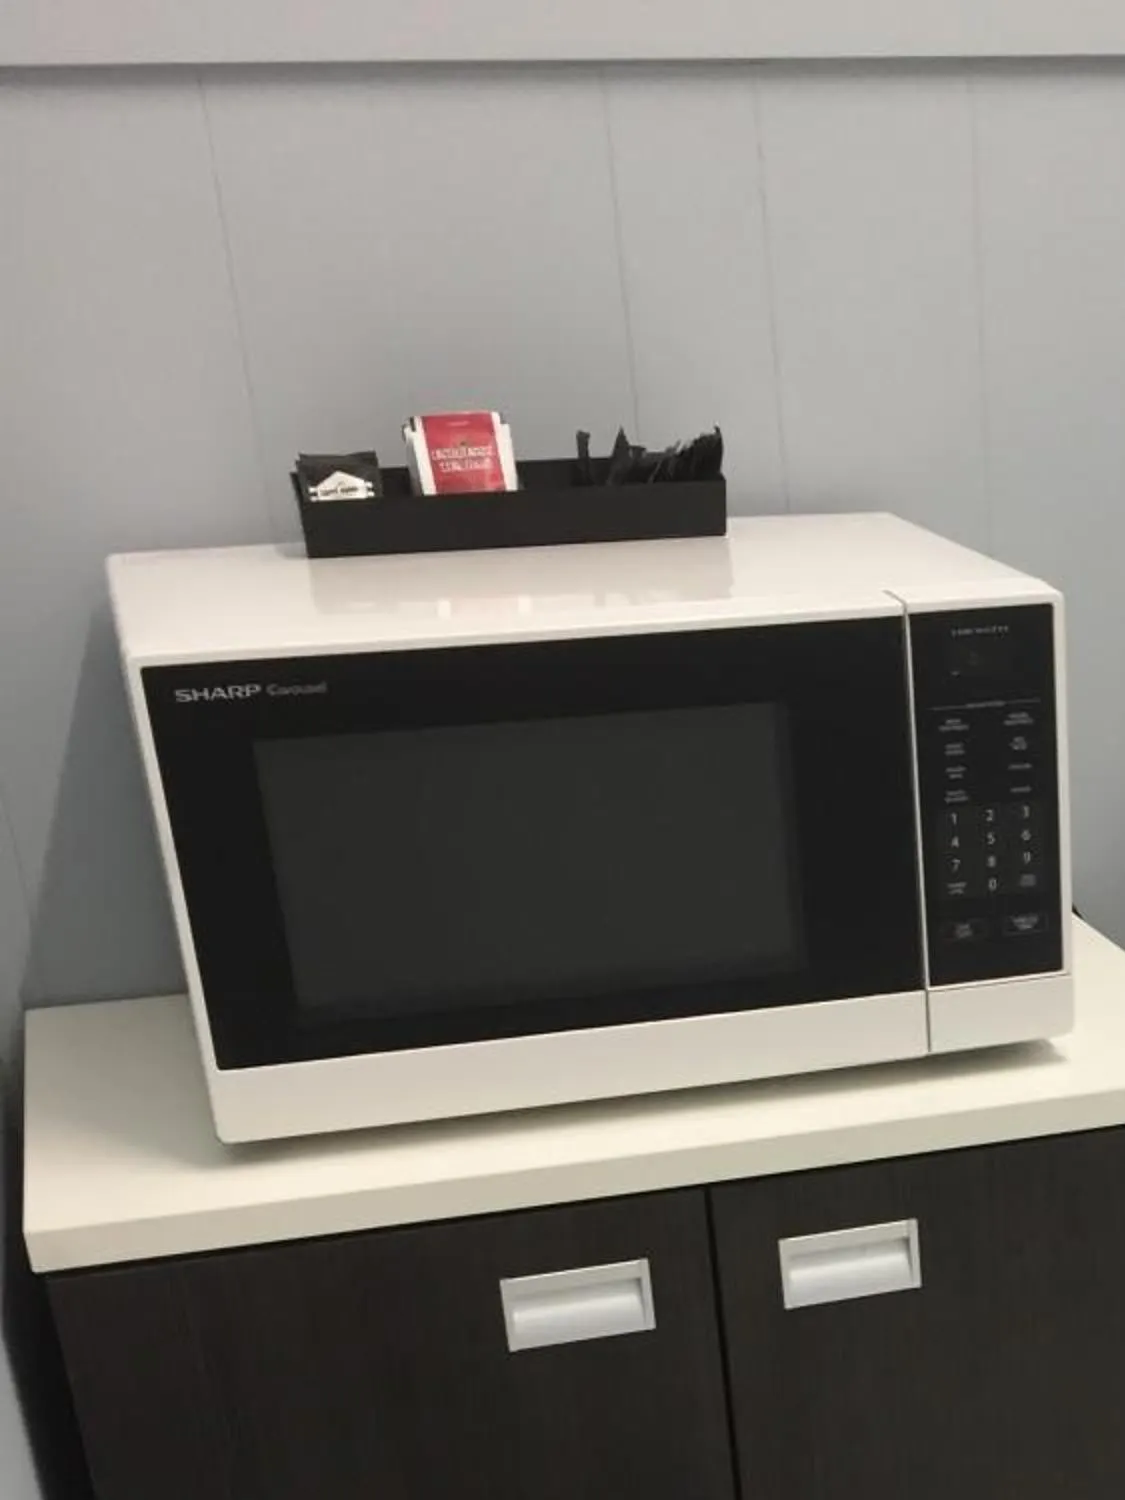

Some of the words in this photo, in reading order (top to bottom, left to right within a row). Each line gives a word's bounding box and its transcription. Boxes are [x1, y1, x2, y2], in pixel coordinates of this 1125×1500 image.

[174, 683, 261, 702] SHARP
[951, 812, 958, 825] 1
[985, 809, 994, 822] 2
[951, 836, 960, 848] 4
[986, 832, 996, 845] 5
[951, 858, 961, 871] 7
